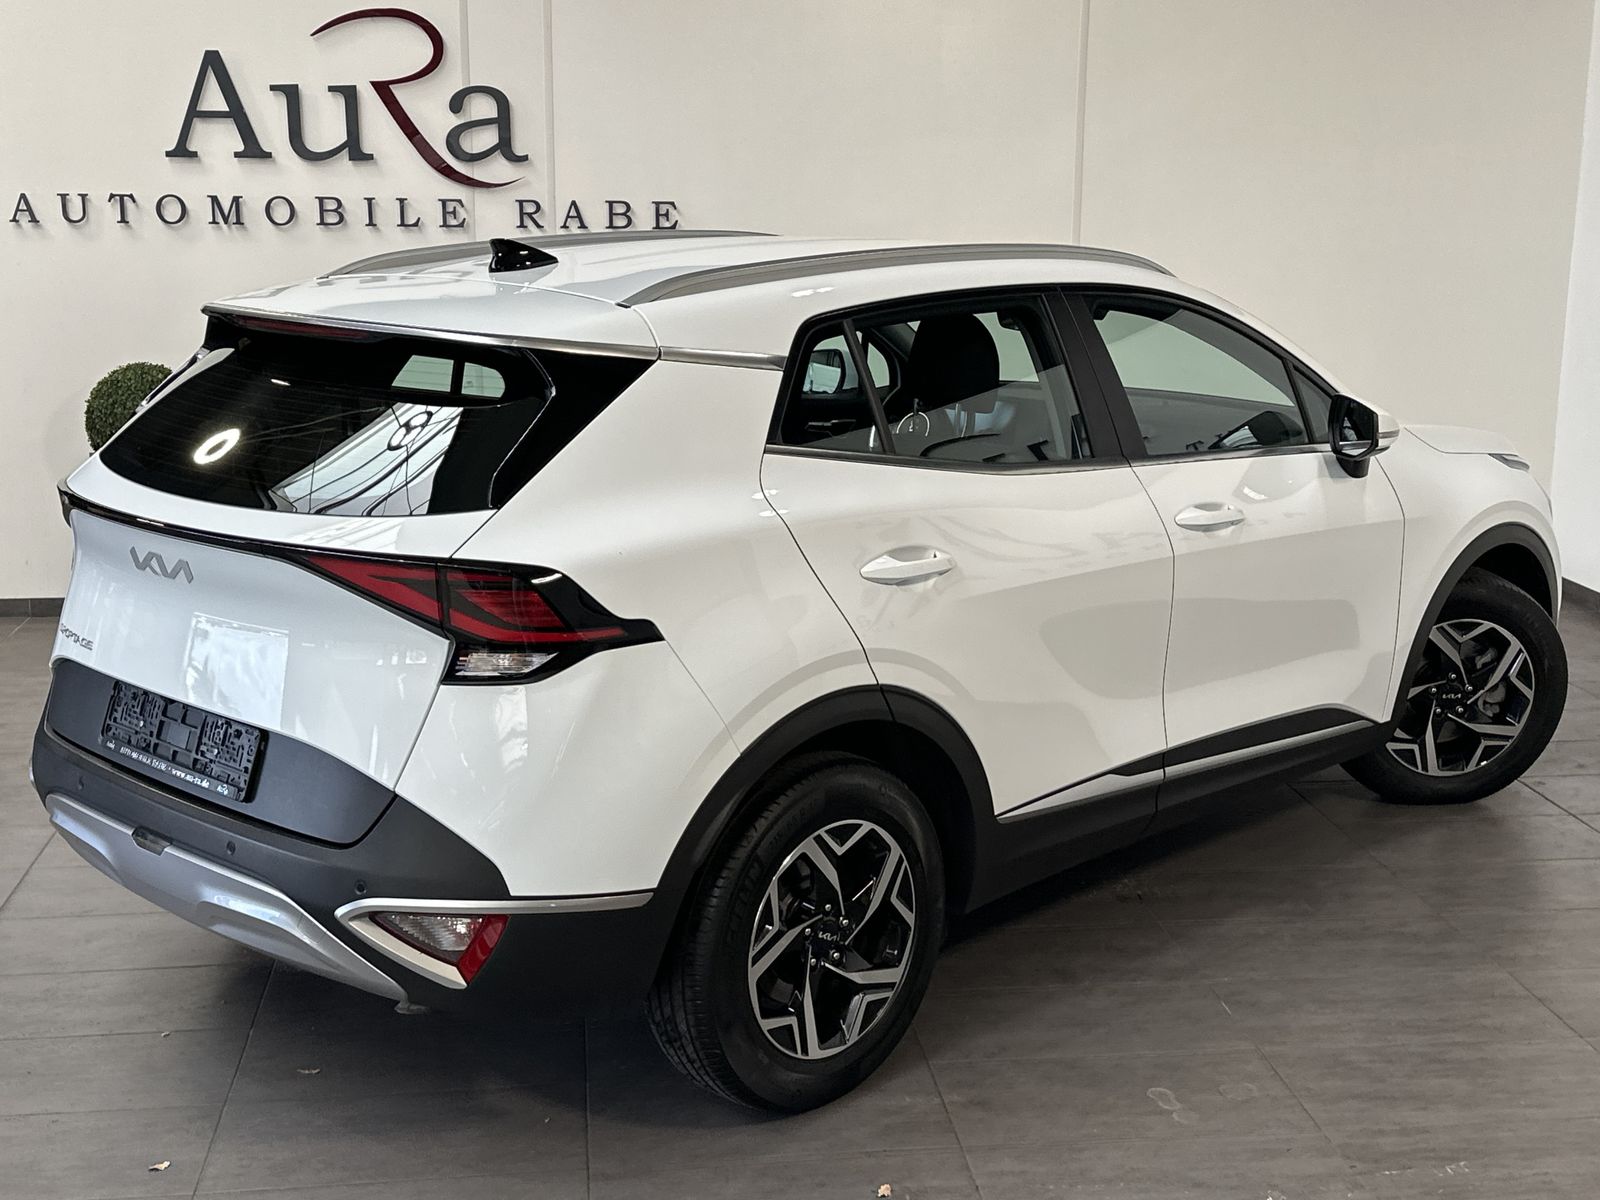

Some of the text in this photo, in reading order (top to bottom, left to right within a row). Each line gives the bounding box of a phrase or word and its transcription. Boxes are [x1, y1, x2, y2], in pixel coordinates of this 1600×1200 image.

[165, 7, 528, 188] AuRa
[10, 192, 680, 230] AUTOMOBILE RABE
[129, 546, 194, 584] KIA
